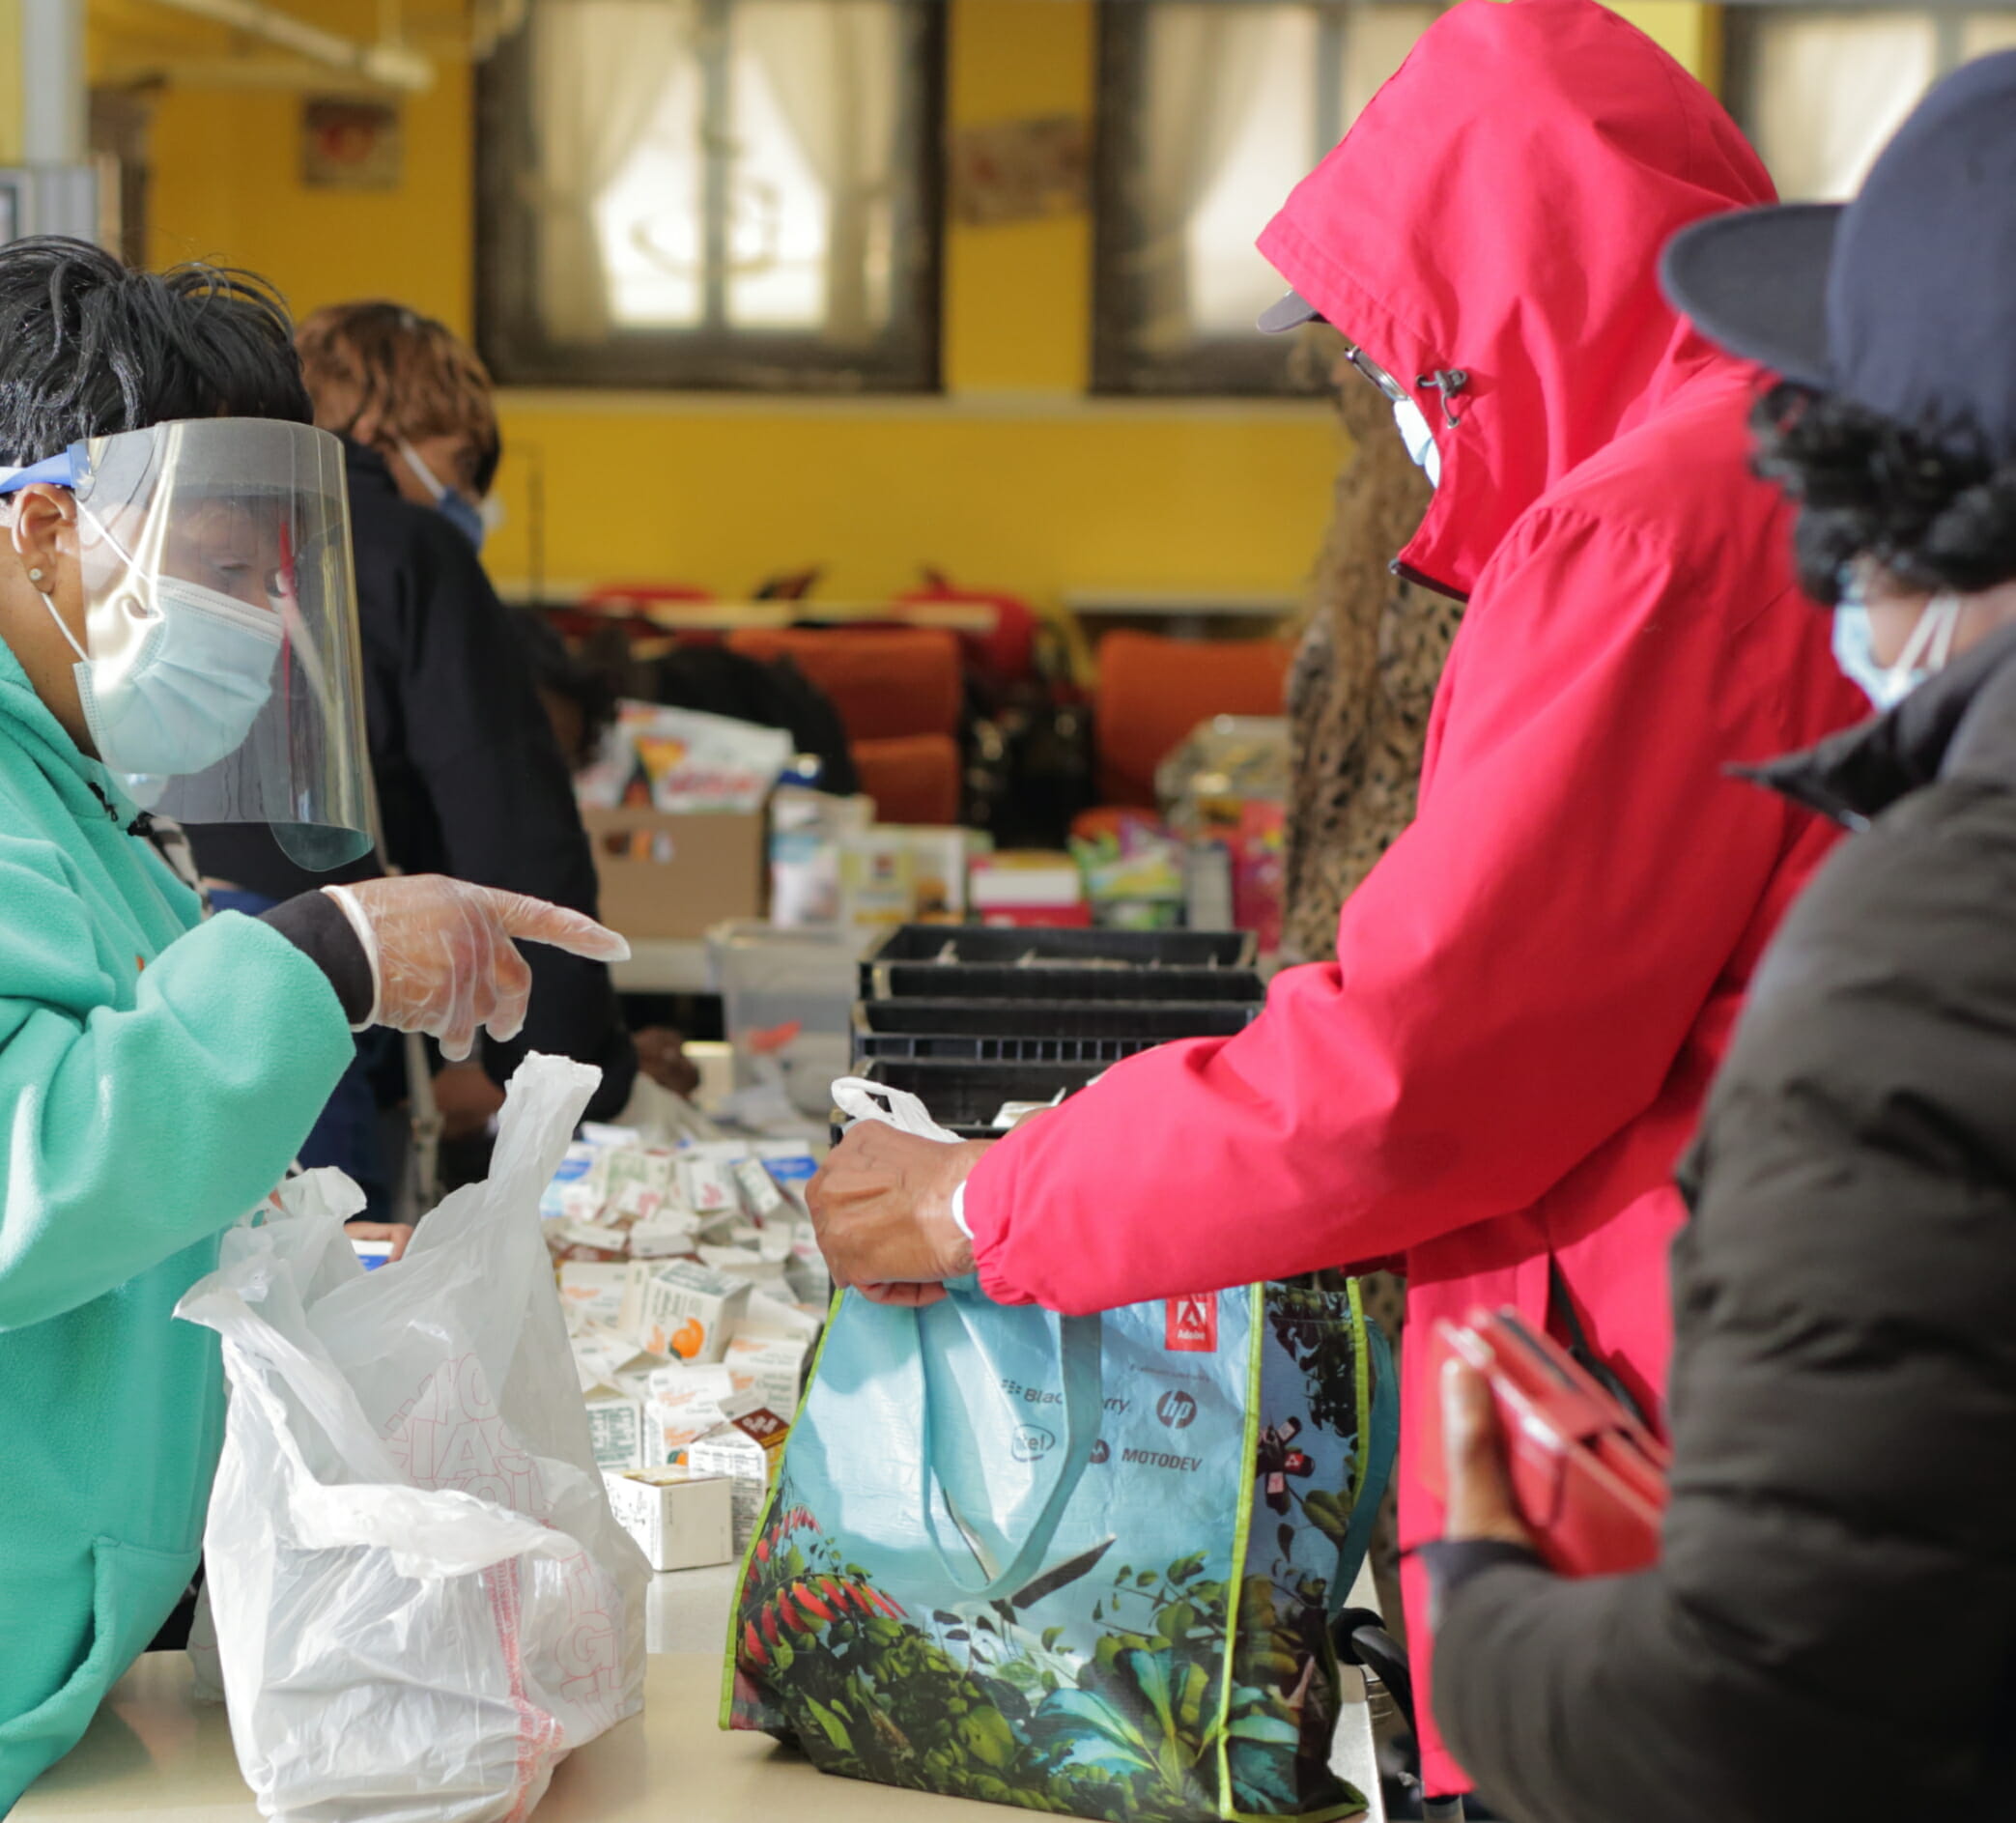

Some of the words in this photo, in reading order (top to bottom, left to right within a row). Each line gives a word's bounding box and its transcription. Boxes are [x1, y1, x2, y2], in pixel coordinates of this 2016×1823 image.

[1177, 1328, 1207, 1340] Adobe
[1024, 1387, 1129, 1414] Blacrry
[1159, 1390, 1195, 1429] hp
[1122, 1447, 1203, 1471] MOTODEV
